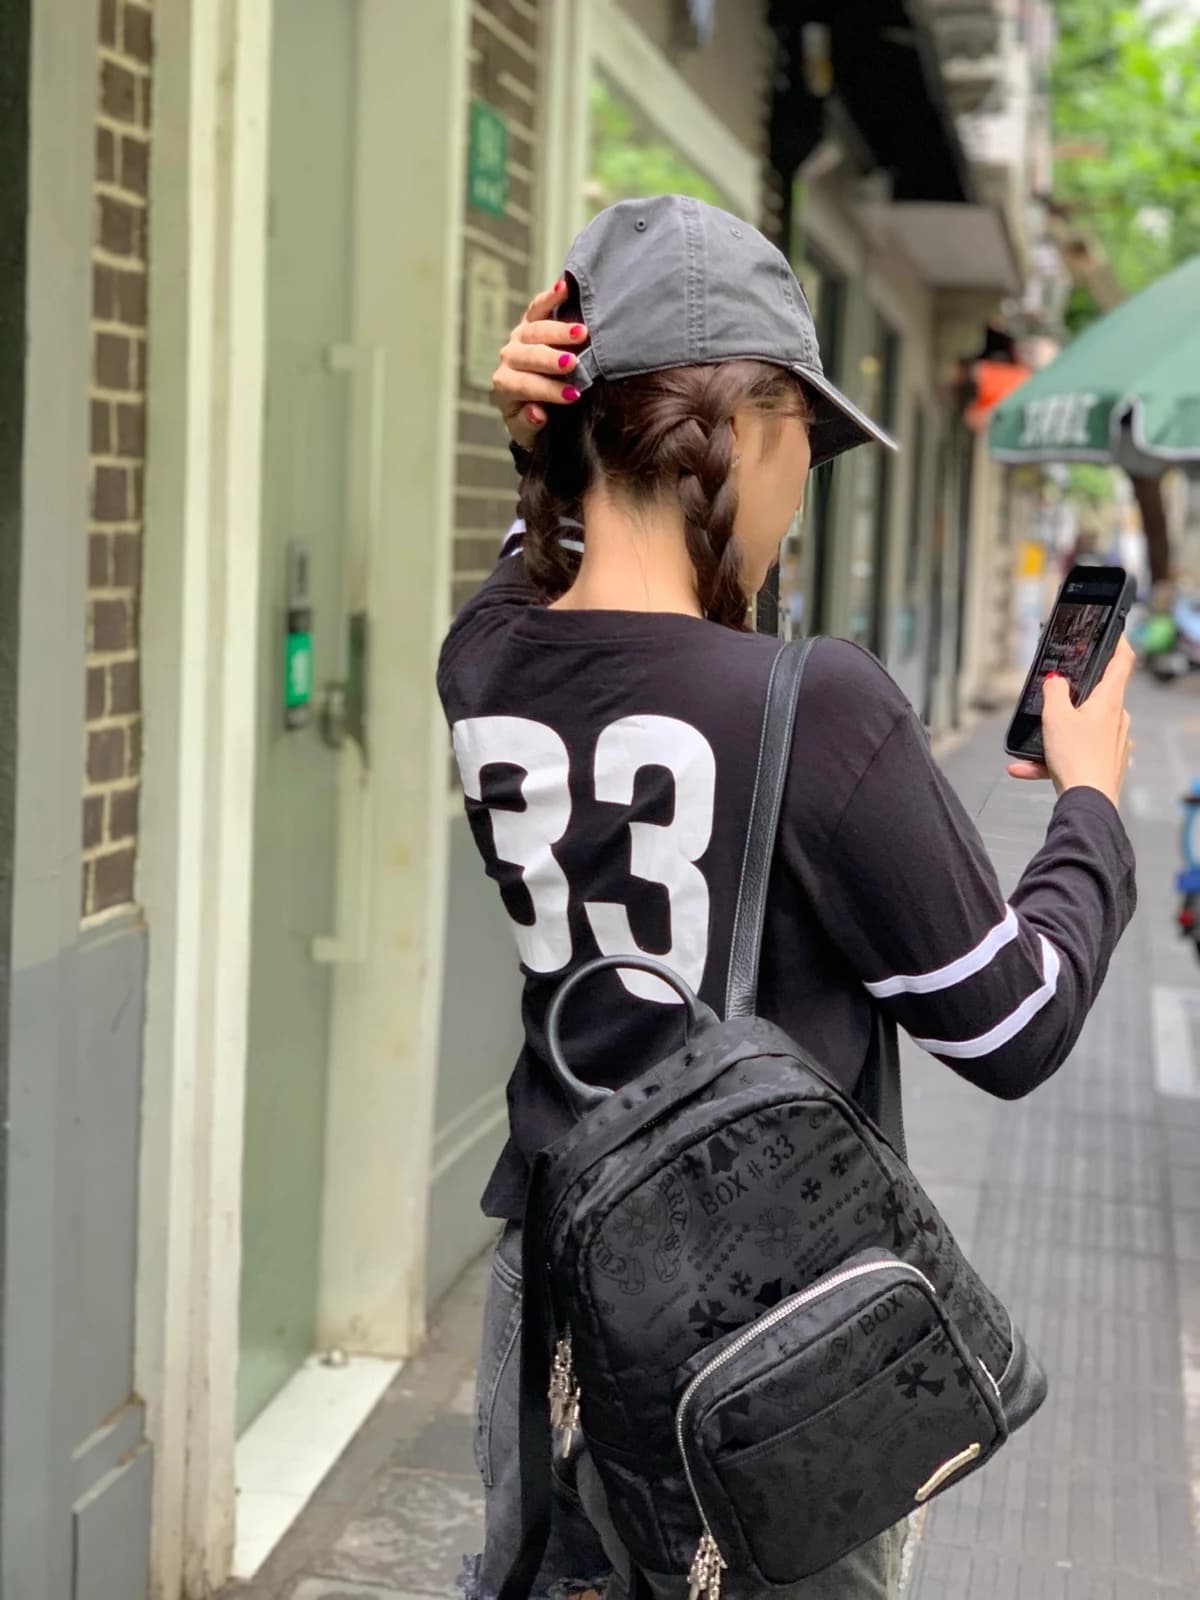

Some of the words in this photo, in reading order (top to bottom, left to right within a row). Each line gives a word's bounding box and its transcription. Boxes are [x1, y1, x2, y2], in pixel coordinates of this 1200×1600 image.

[453, 714, 716, 1004] 33
[699, 1170, 749, 1217] BOX
[858, 1294, 904, 1336] BOX
